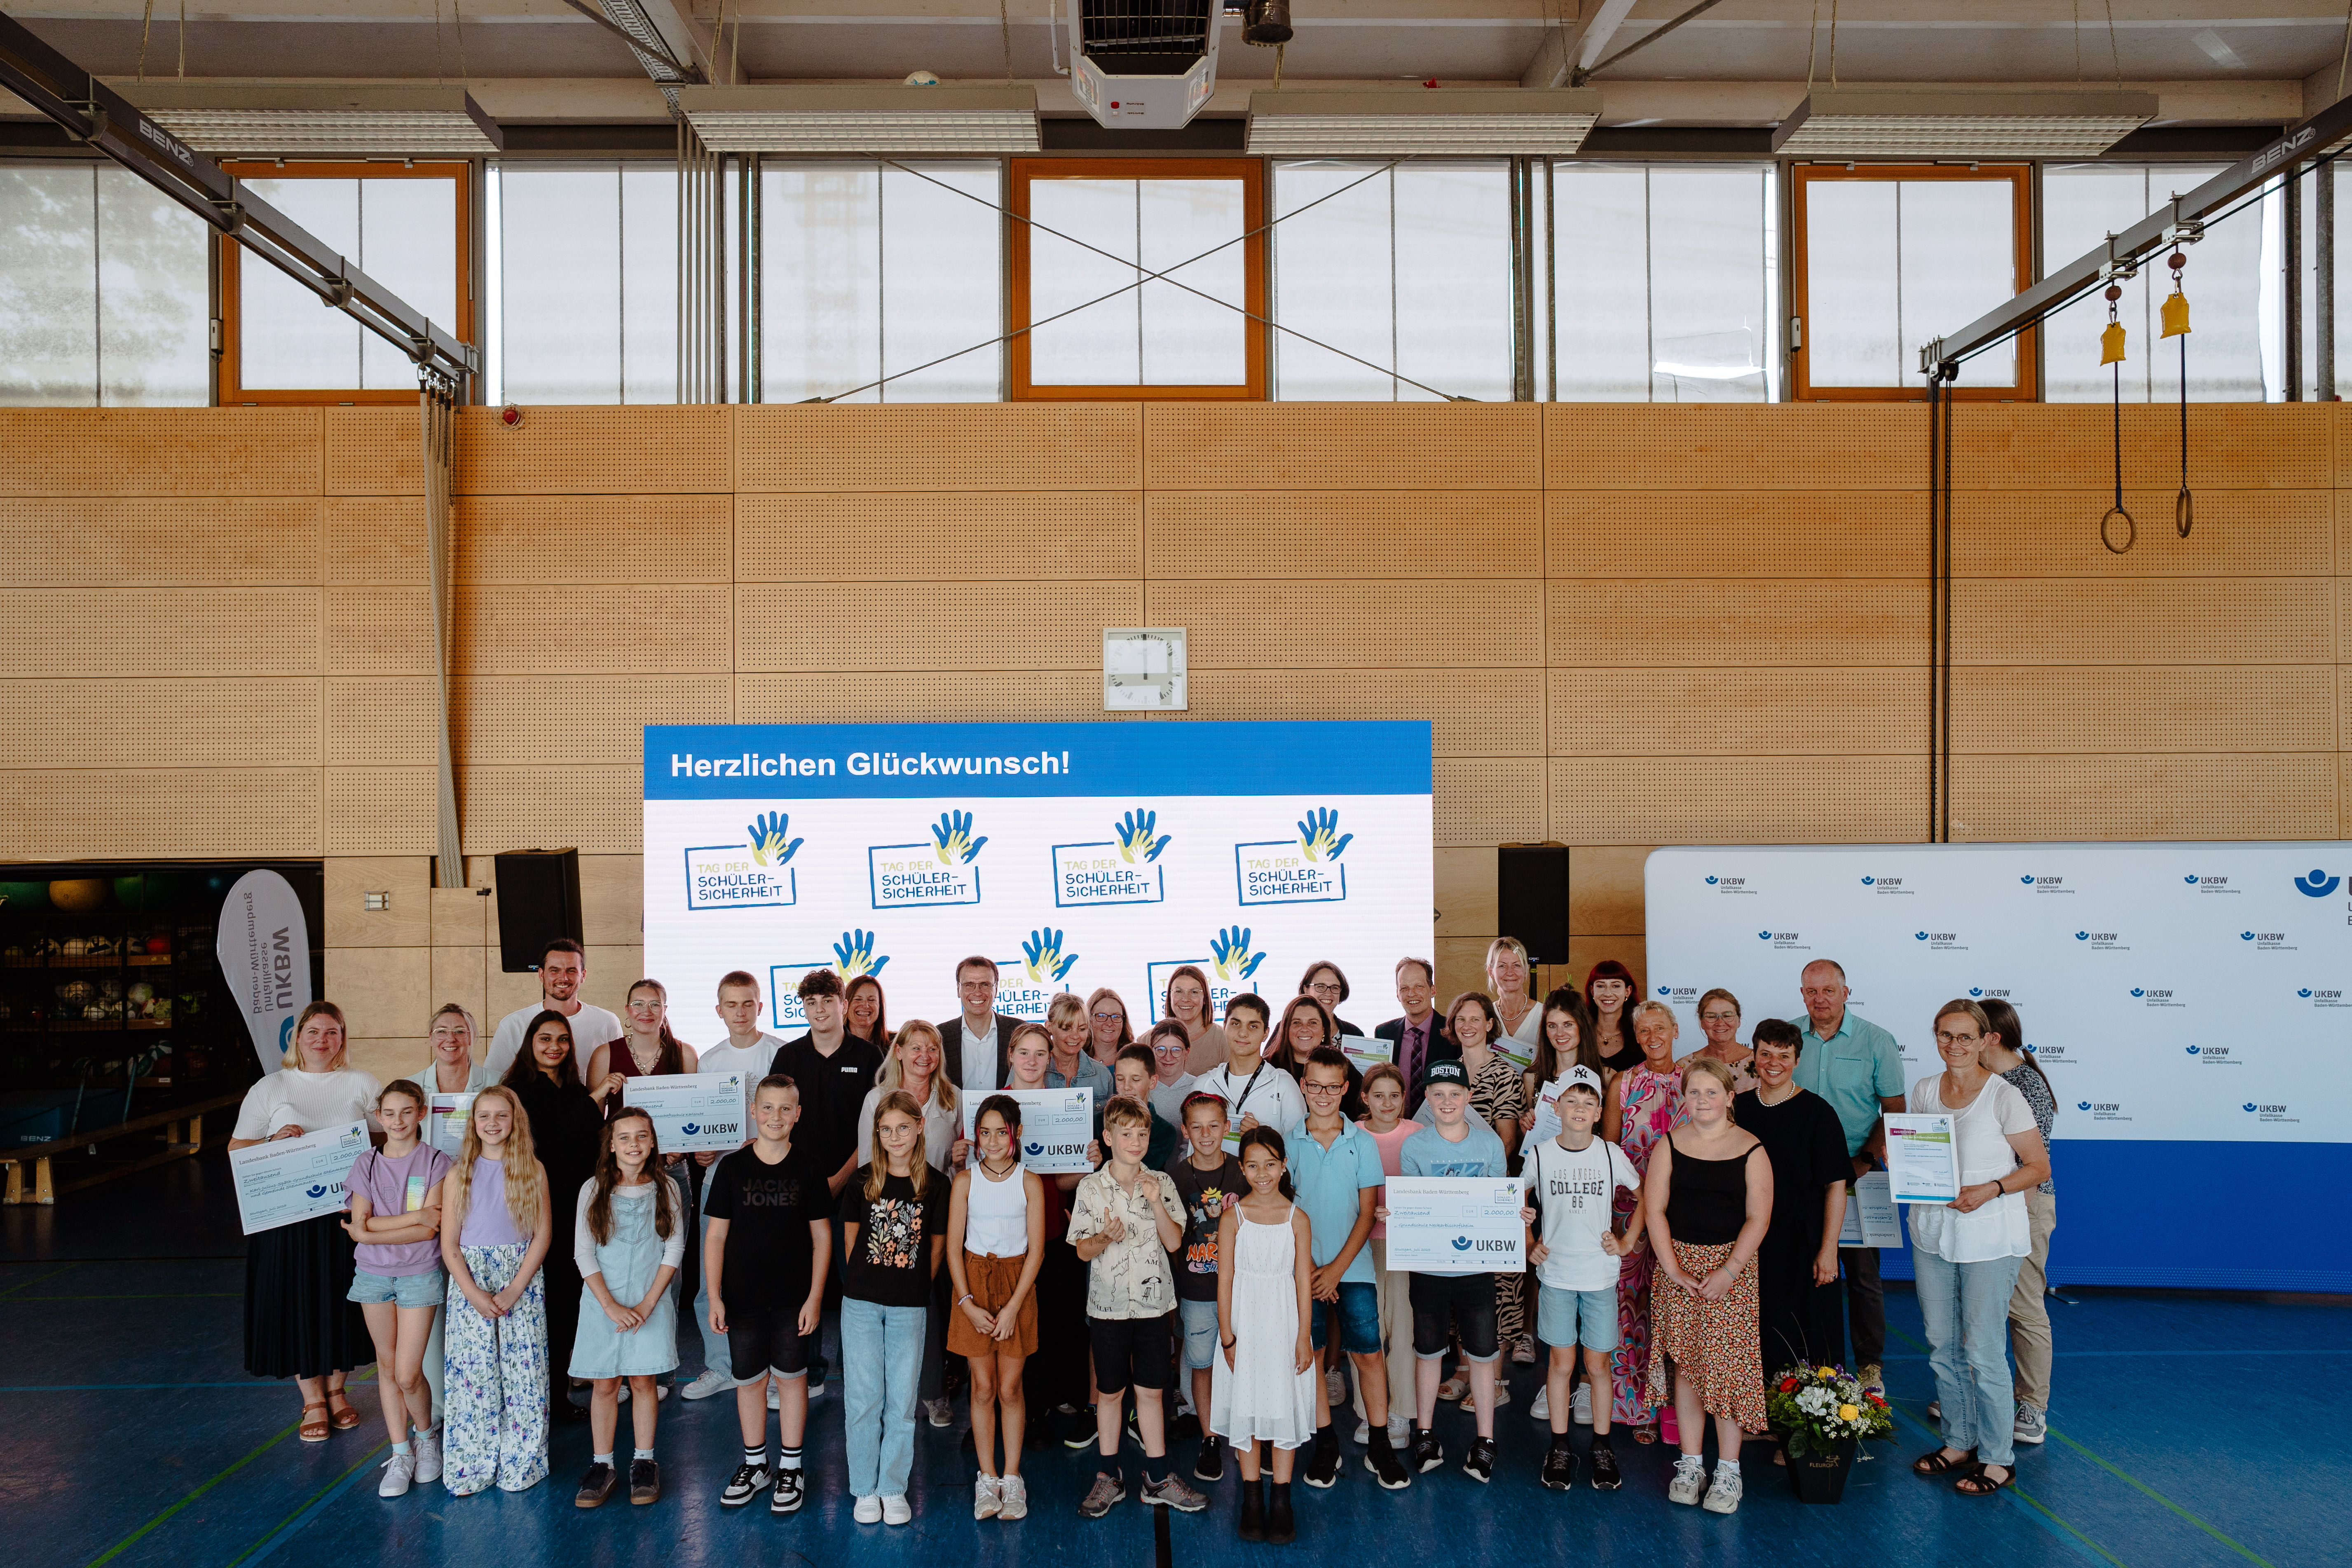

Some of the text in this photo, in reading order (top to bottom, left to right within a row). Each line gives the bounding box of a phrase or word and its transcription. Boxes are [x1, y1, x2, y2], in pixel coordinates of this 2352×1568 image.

[140, 119, 191, 163] BENZ
[2251, 127, 2312, 173] BENZ
[672, 751, 1068, 776] Herzlichen Glückwunsch!
[697, 863, 748, 873] TAG DER
[881, 861, 932, 872] TAG DER
[1064, 860, 1116, 870] TAG DER
[1247, 858, 1298, 870] TAG DER
[698, 874, 775, 888] SCHÜLER-
[882, 872, 959, 887] SCHÜLER-
[1066, 871, 1142, 886] SCHÜLER-
[1249, 870, 1325, 884] SCHÜLER-
[699, 885, 782, 900] SICHERHEIT
[883, 884, 966, 899] SICHERHEIT
[1066, 882, 1150, 897] SICHERHEIT
[1249, 881, 1332, 895] SICHERHEIT
[1000, 979, 1023, 988] DER
[1431, 1066, 1460, 1077] BOSTON
[703, 1123, 738, 1134] UKBW
[239, 1144, 316, 1165] Landesbank Baden-Württemberg
[333, 1150, 362, 1160] 2.000,00
[1048, 1144, 1085, 1155] UKBW
[323, 1165, 353, 1174] Steinmauern
[1554, 1168, 1601, 1180] LOS ANGELS
[244, 1172, 280, 1184] Zweitausend
[262, 1187, 285, 1195] Gemeinde
[286, 1179, 316, 1189] Steinmauern
[743, 1179, 799, 1192] JACK&
[1551, 1180, 1604, 1195] COLLEGE
[743, 1192, 799, 1206] JONES
[1572, 1196, 1583, 1207] 86
[1476, 1240, 1516, 1251] UKBW
